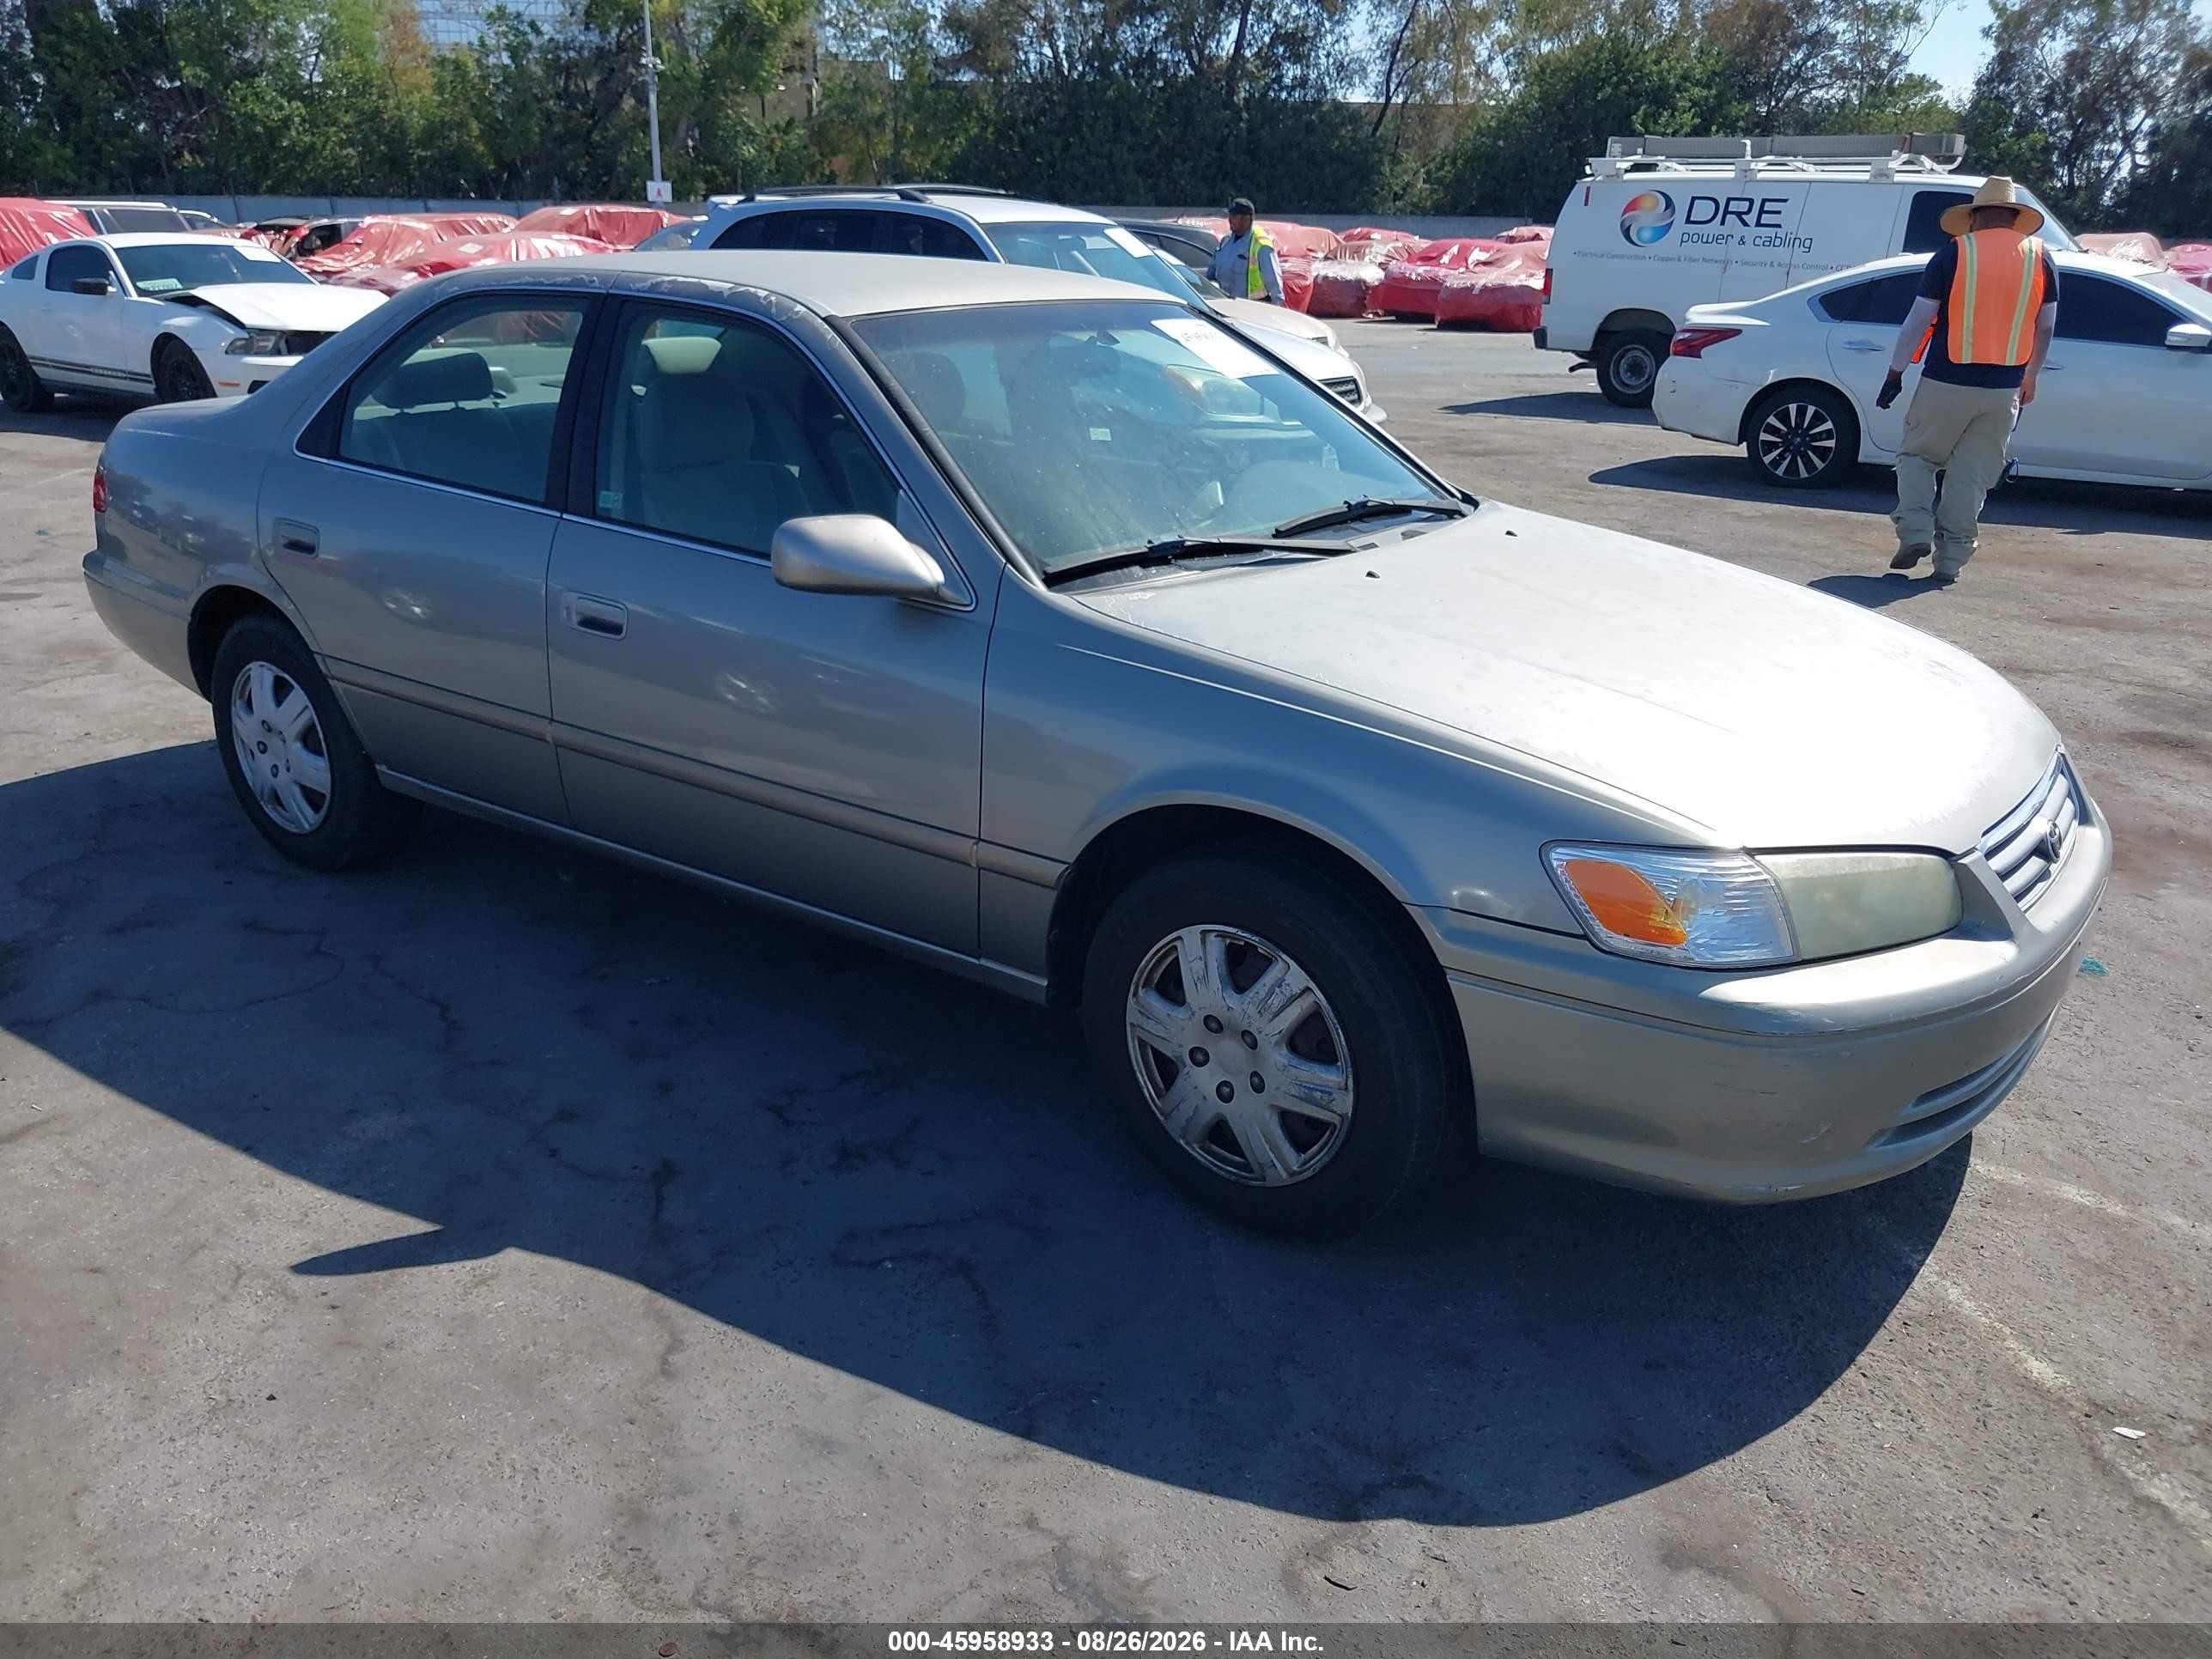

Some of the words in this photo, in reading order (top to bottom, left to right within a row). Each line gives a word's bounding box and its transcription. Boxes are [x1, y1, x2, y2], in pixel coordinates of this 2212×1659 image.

[1685, 196, 1790, 228] DRE
[1680, 232, 1734, 247] power
[1737, 235, 1747, 246] &
[1753, 231, 1814, 253] cabling
[1740, 258, 1767, 268] Security
[1802, 262, 1829, 270] Control
